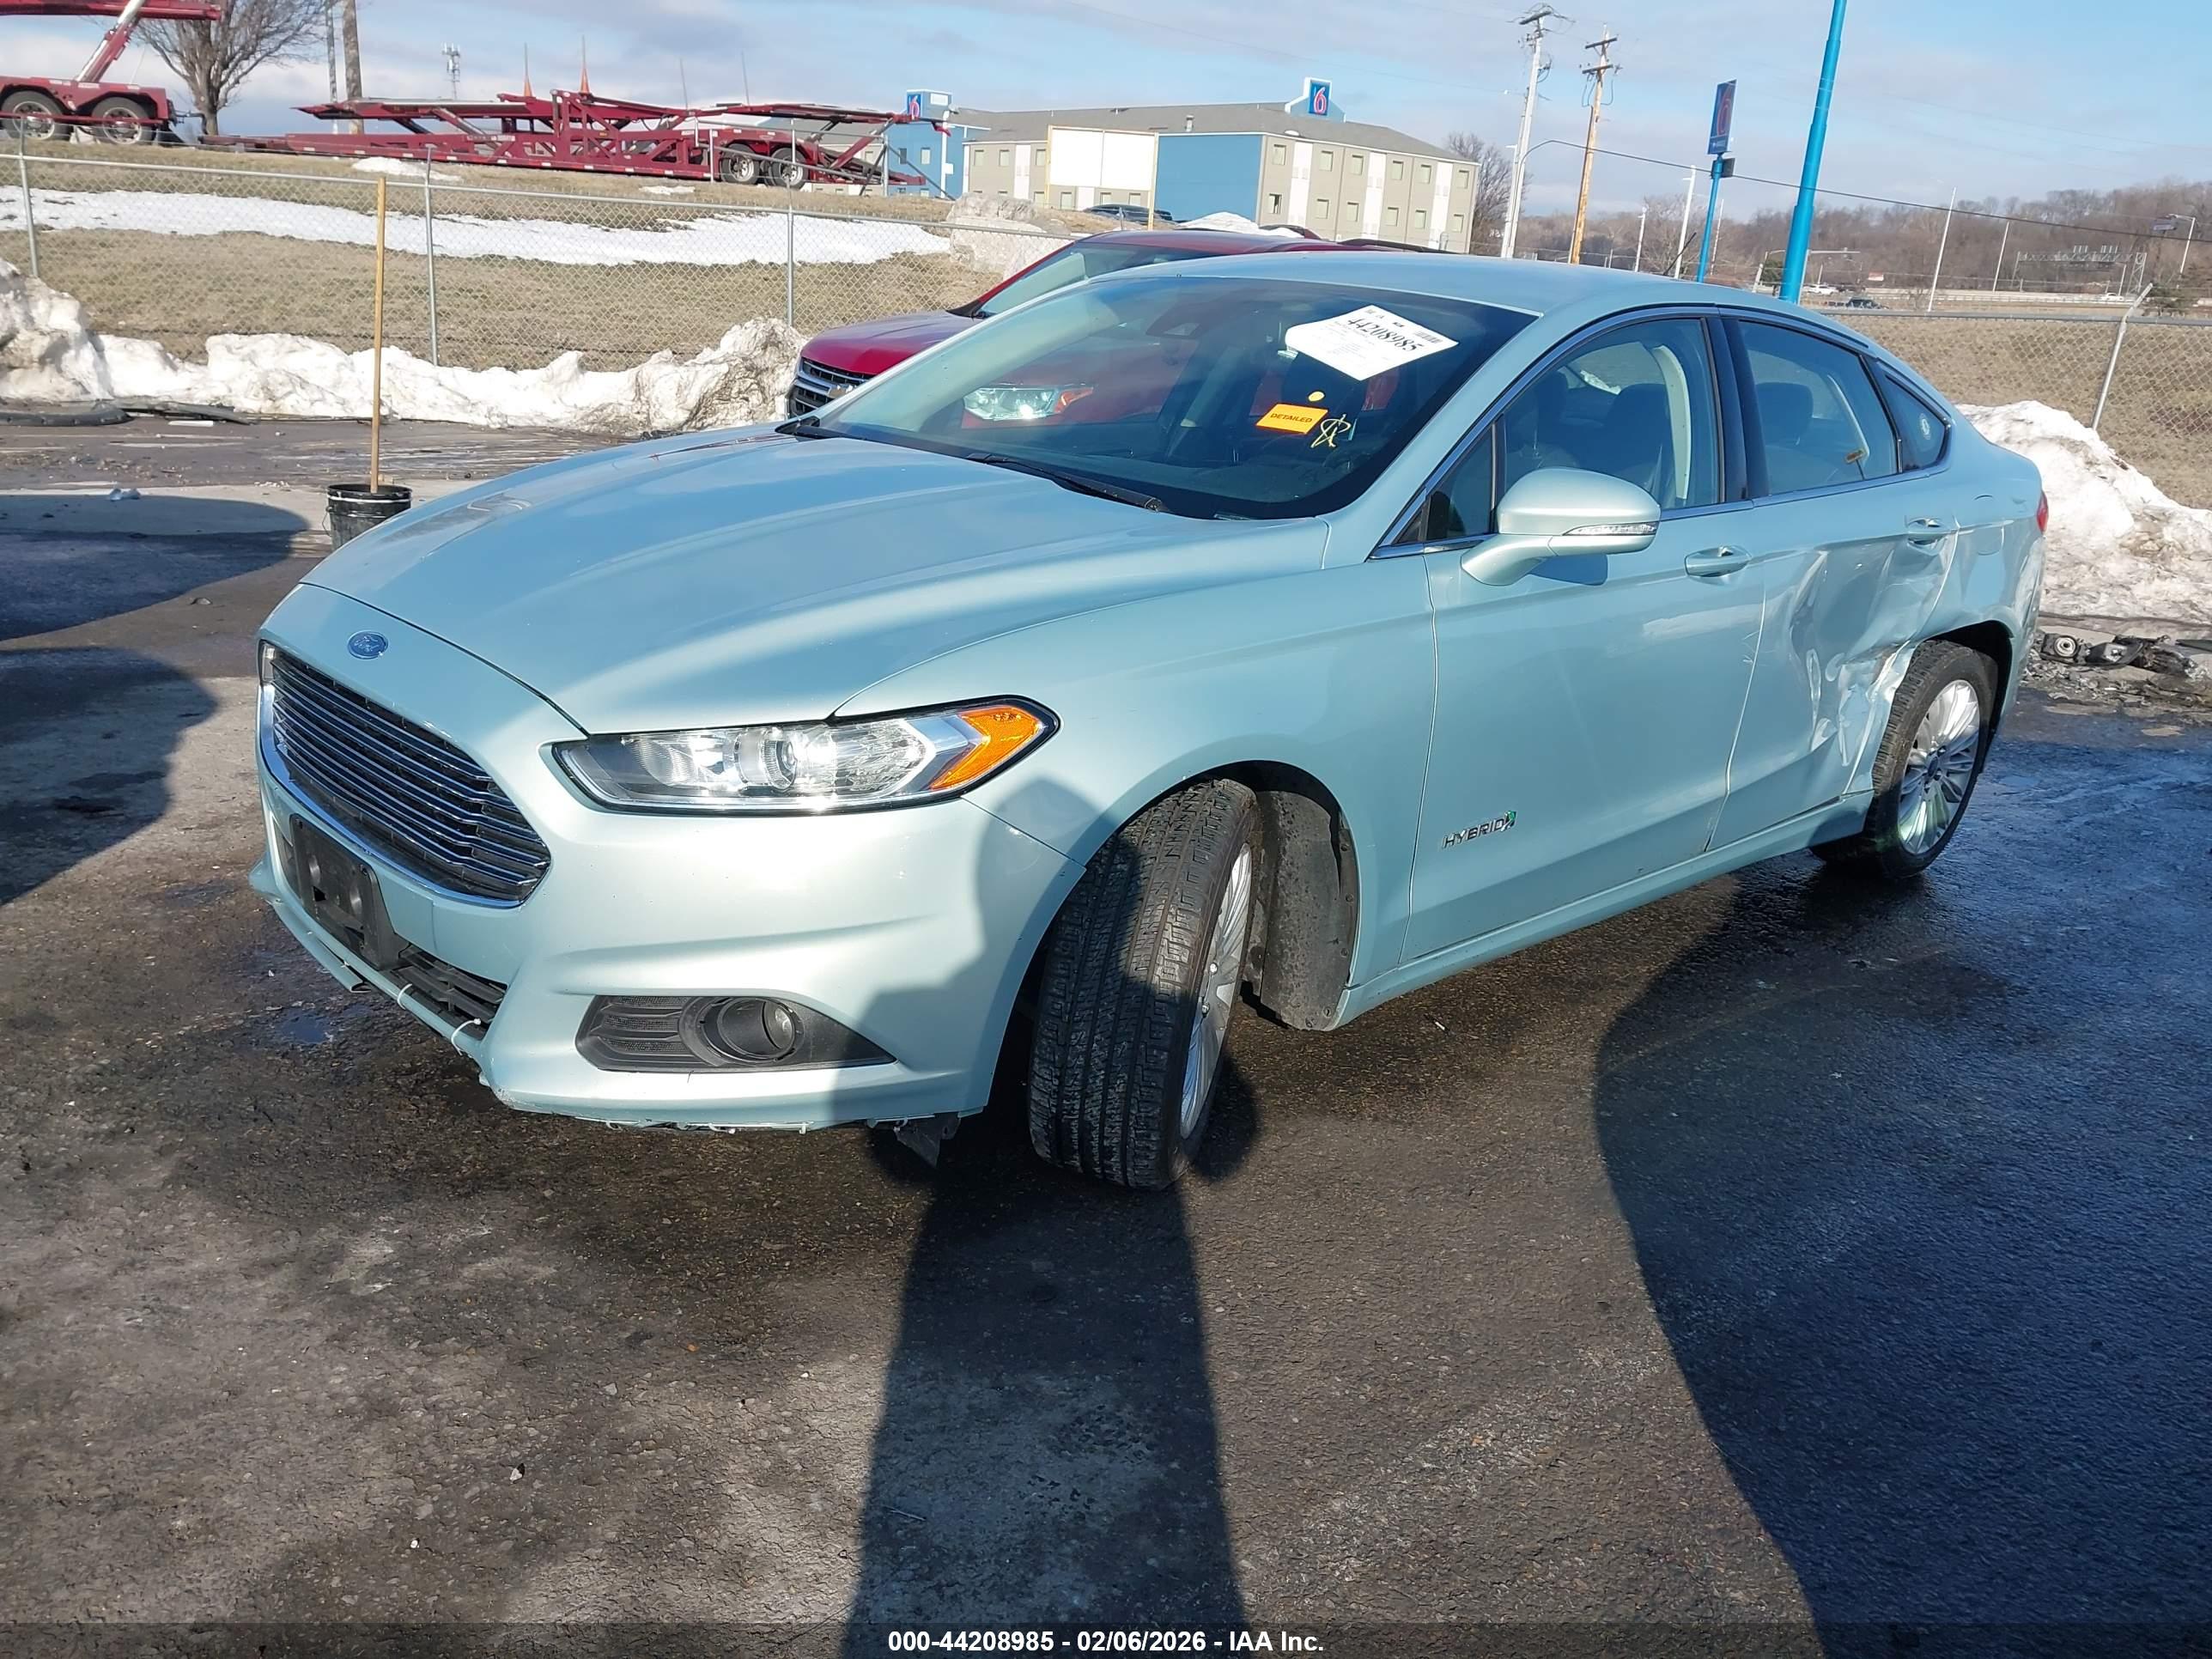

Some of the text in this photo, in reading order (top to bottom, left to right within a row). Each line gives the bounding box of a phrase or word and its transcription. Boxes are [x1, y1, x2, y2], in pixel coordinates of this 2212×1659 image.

[1314, 87, 1327, 113] 6
[1346, 316, 1425, 351] 44208985
[1270, 412, 1313, 423] DETAILED
[1443, 817, 1505, 848] HYBRID
